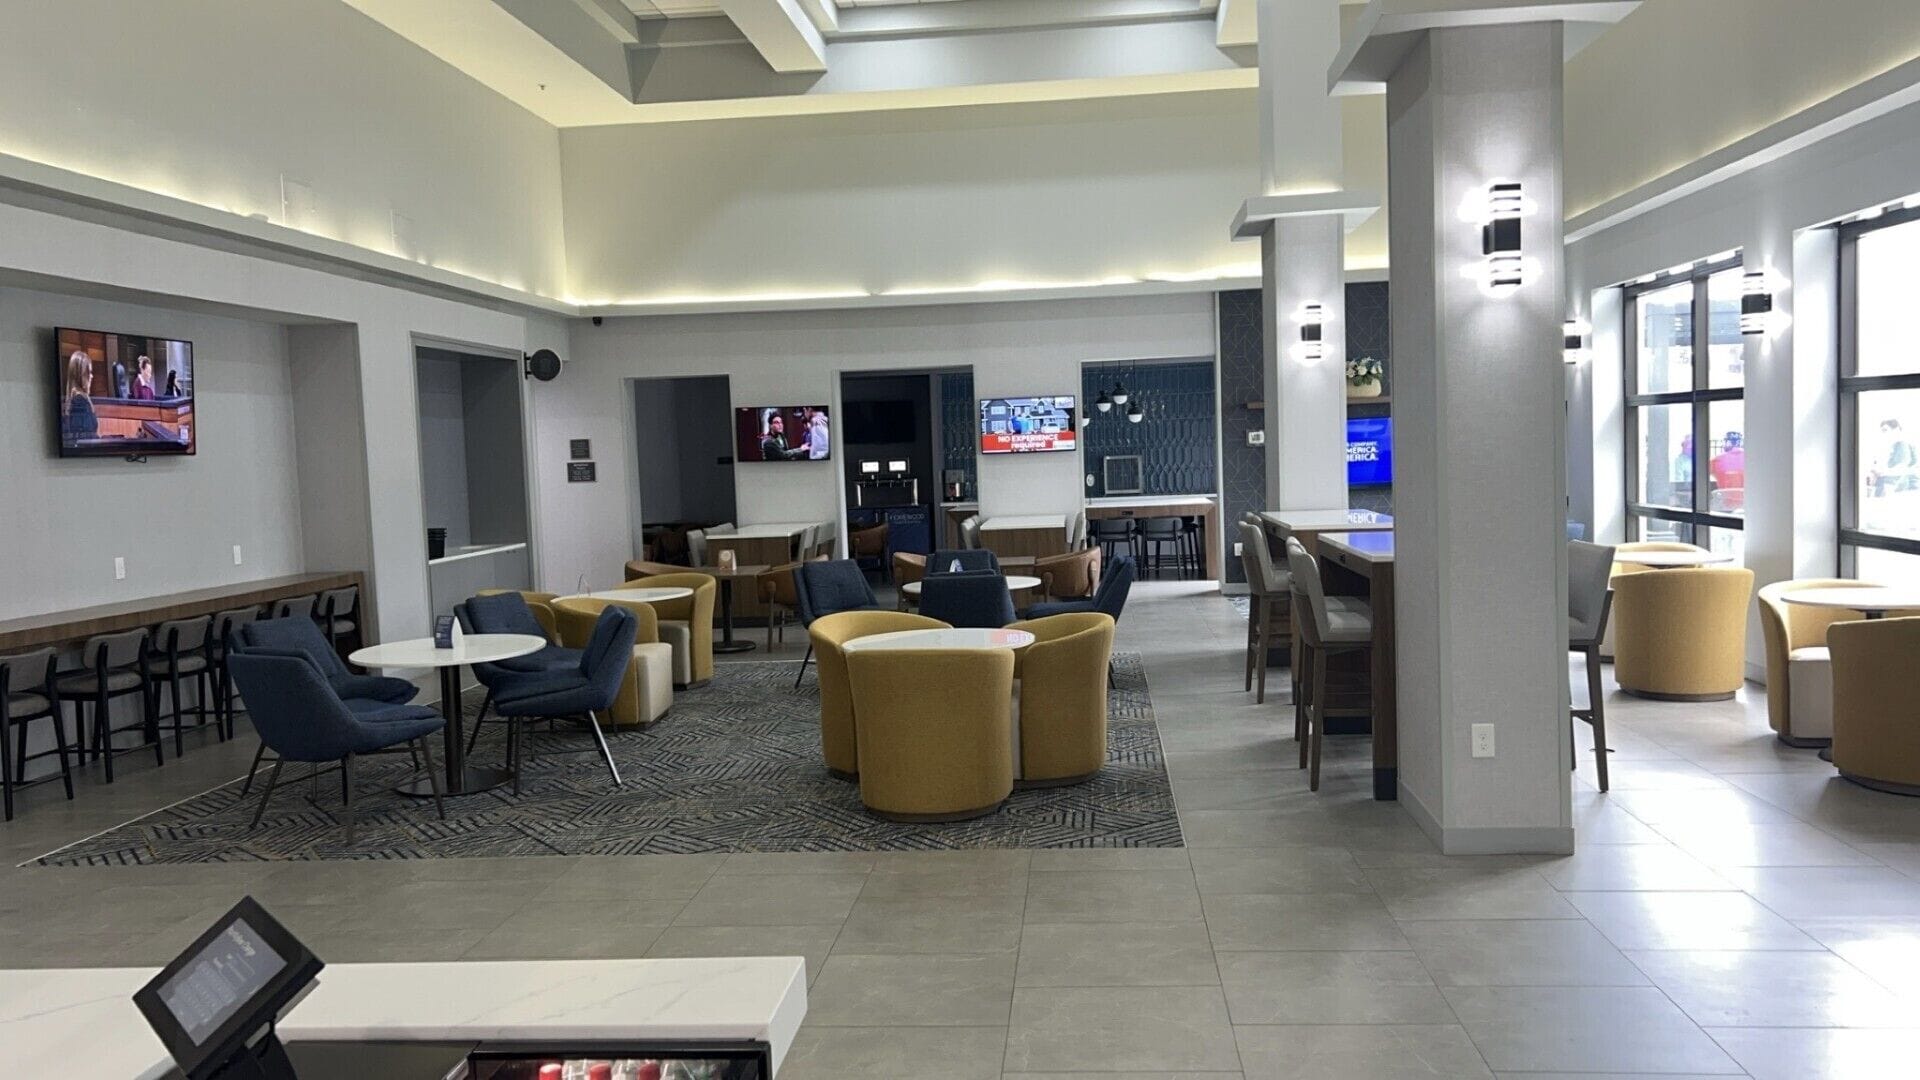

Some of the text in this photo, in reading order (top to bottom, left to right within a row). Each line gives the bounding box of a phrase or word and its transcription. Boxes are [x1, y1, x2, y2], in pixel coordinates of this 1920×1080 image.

[998, 433, 1059, 443] NO EXPERIENCE
[1347, 453, 1379, 461] ERICA.
